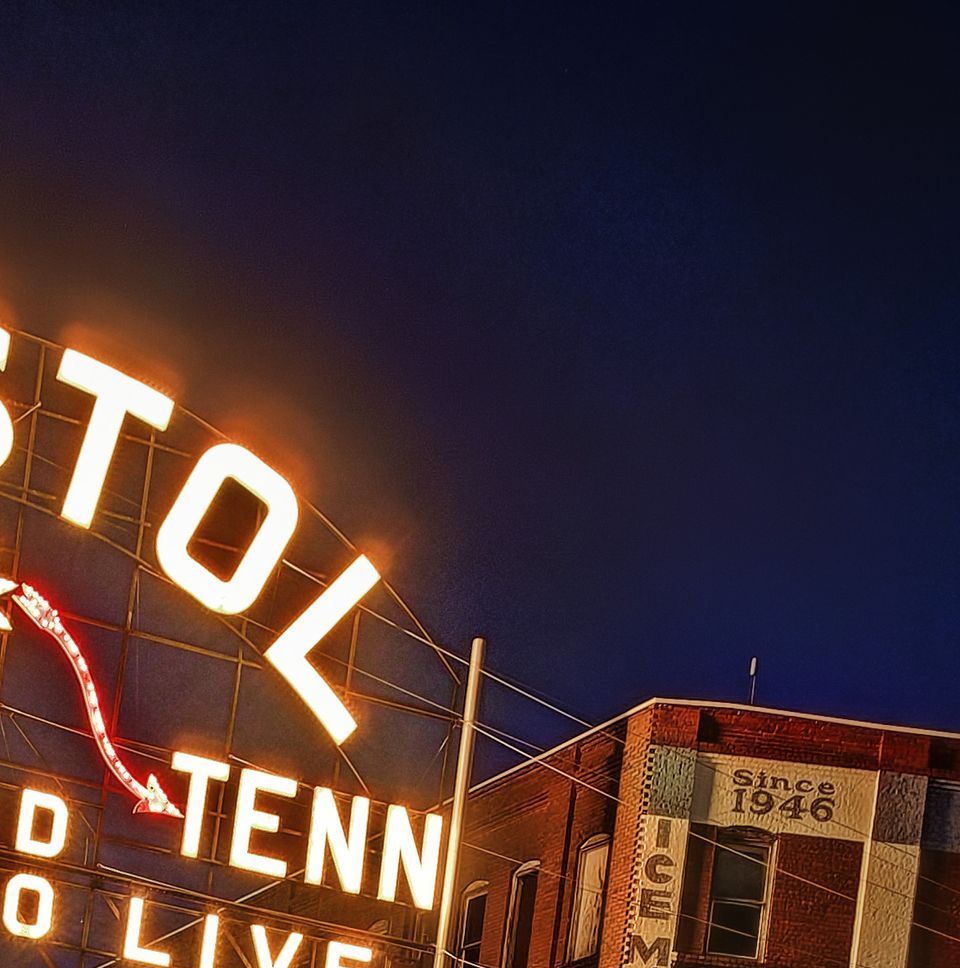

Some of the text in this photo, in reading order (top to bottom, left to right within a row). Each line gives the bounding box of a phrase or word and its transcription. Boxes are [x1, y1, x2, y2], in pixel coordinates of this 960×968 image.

[732, 768, 836, 795] Since
[732, 788, 836, 822] 1946
[170, 751, 443, 910] TENN
[641, 819, 677, 920] ICE
